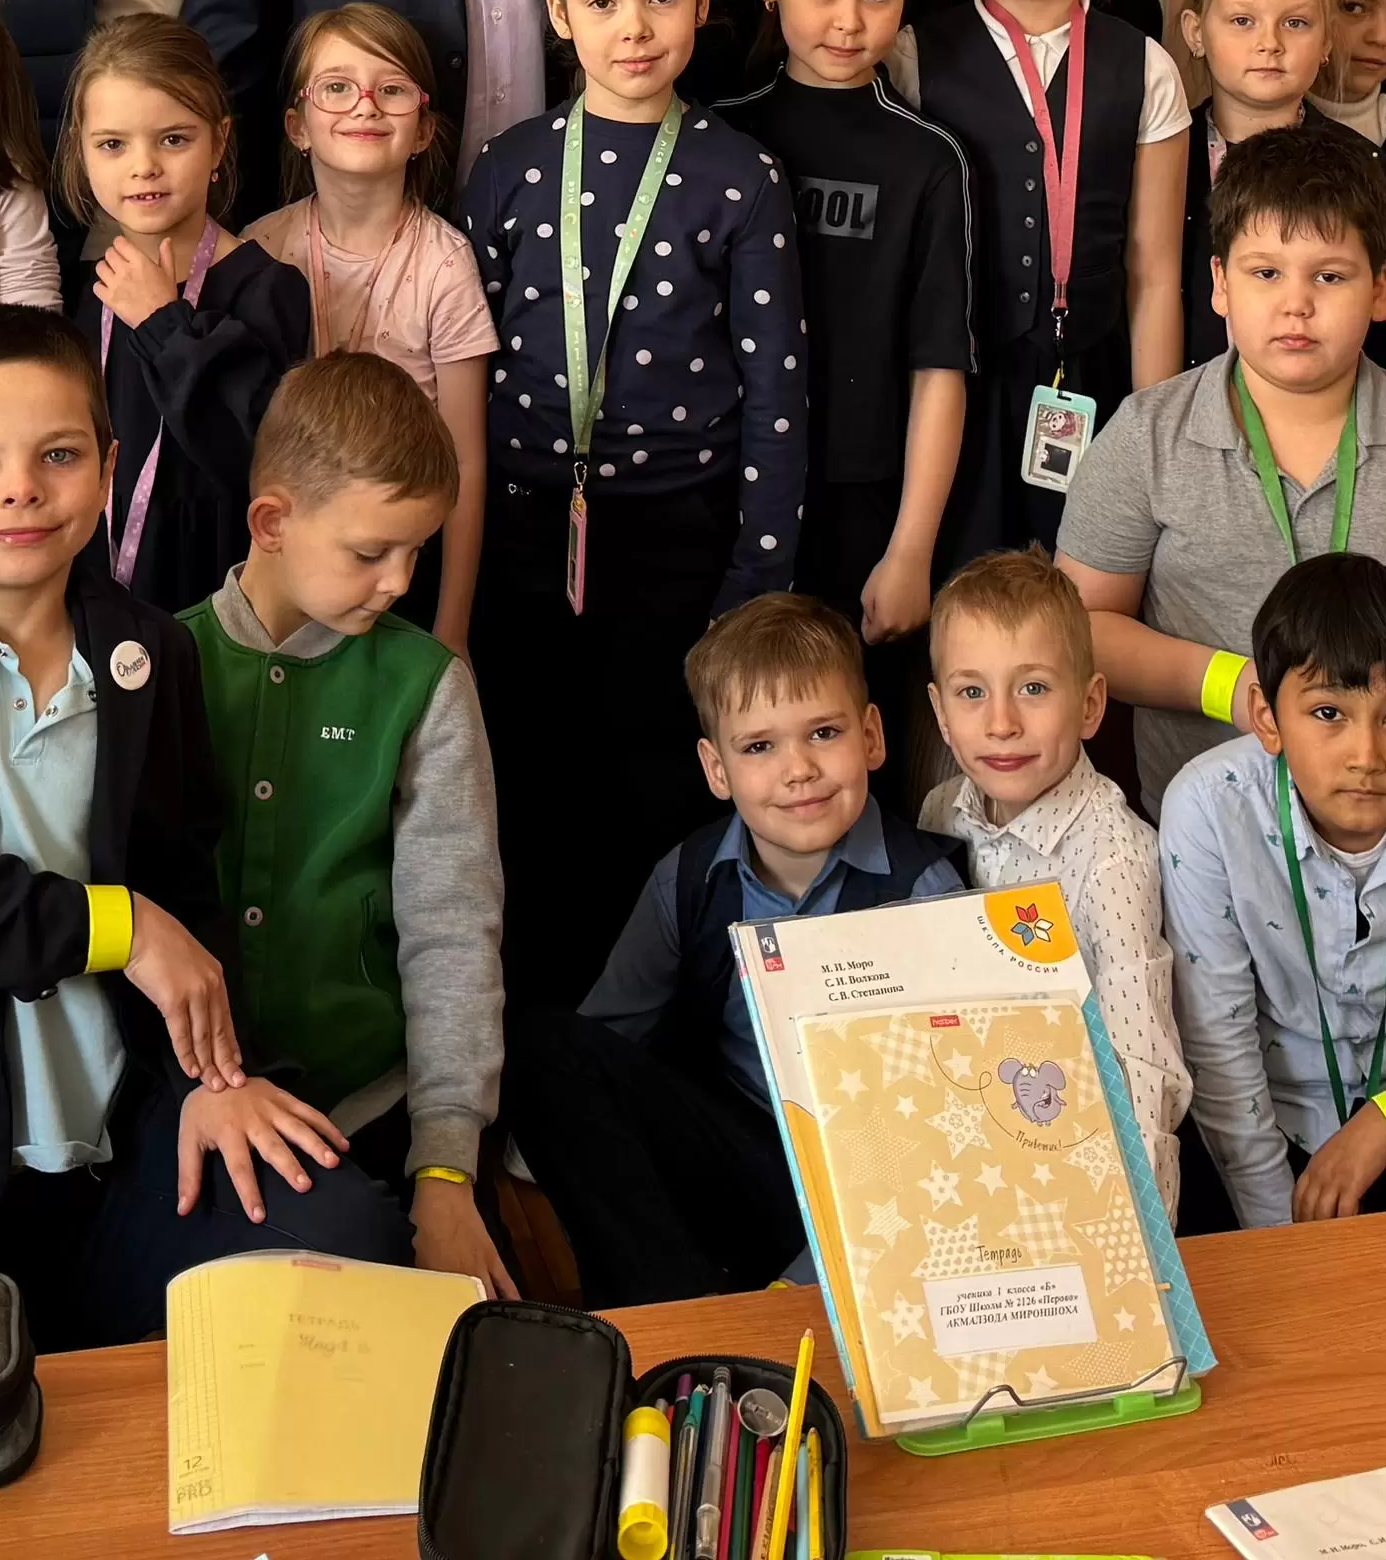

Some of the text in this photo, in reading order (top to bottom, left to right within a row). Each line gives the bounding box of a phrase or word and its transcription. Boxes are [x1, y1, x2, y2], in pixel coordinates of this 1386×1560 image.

[320, 725, 356, 741] EMT
[977, 915, 1059, 974] ШКОЛА РОССИИ
[847, 959, 874, 973] Моро
[849, 972, 890, 985] Волкова
[851, 984, 904, 999] Степанова
[977, 1245, 1023, 1265] Тетрадь
[957, 1290, 992, 1301] ученика
[1007, 1285, 1036, 1294] класса
[940, 1305, 966, 1316] ГБОУ
[969, 1301, 1002, 1313] Школы
[1017, 1297, 1036, 1307] 2126
[1011, 1305, 1078, 1320] МИРОНШОХА
